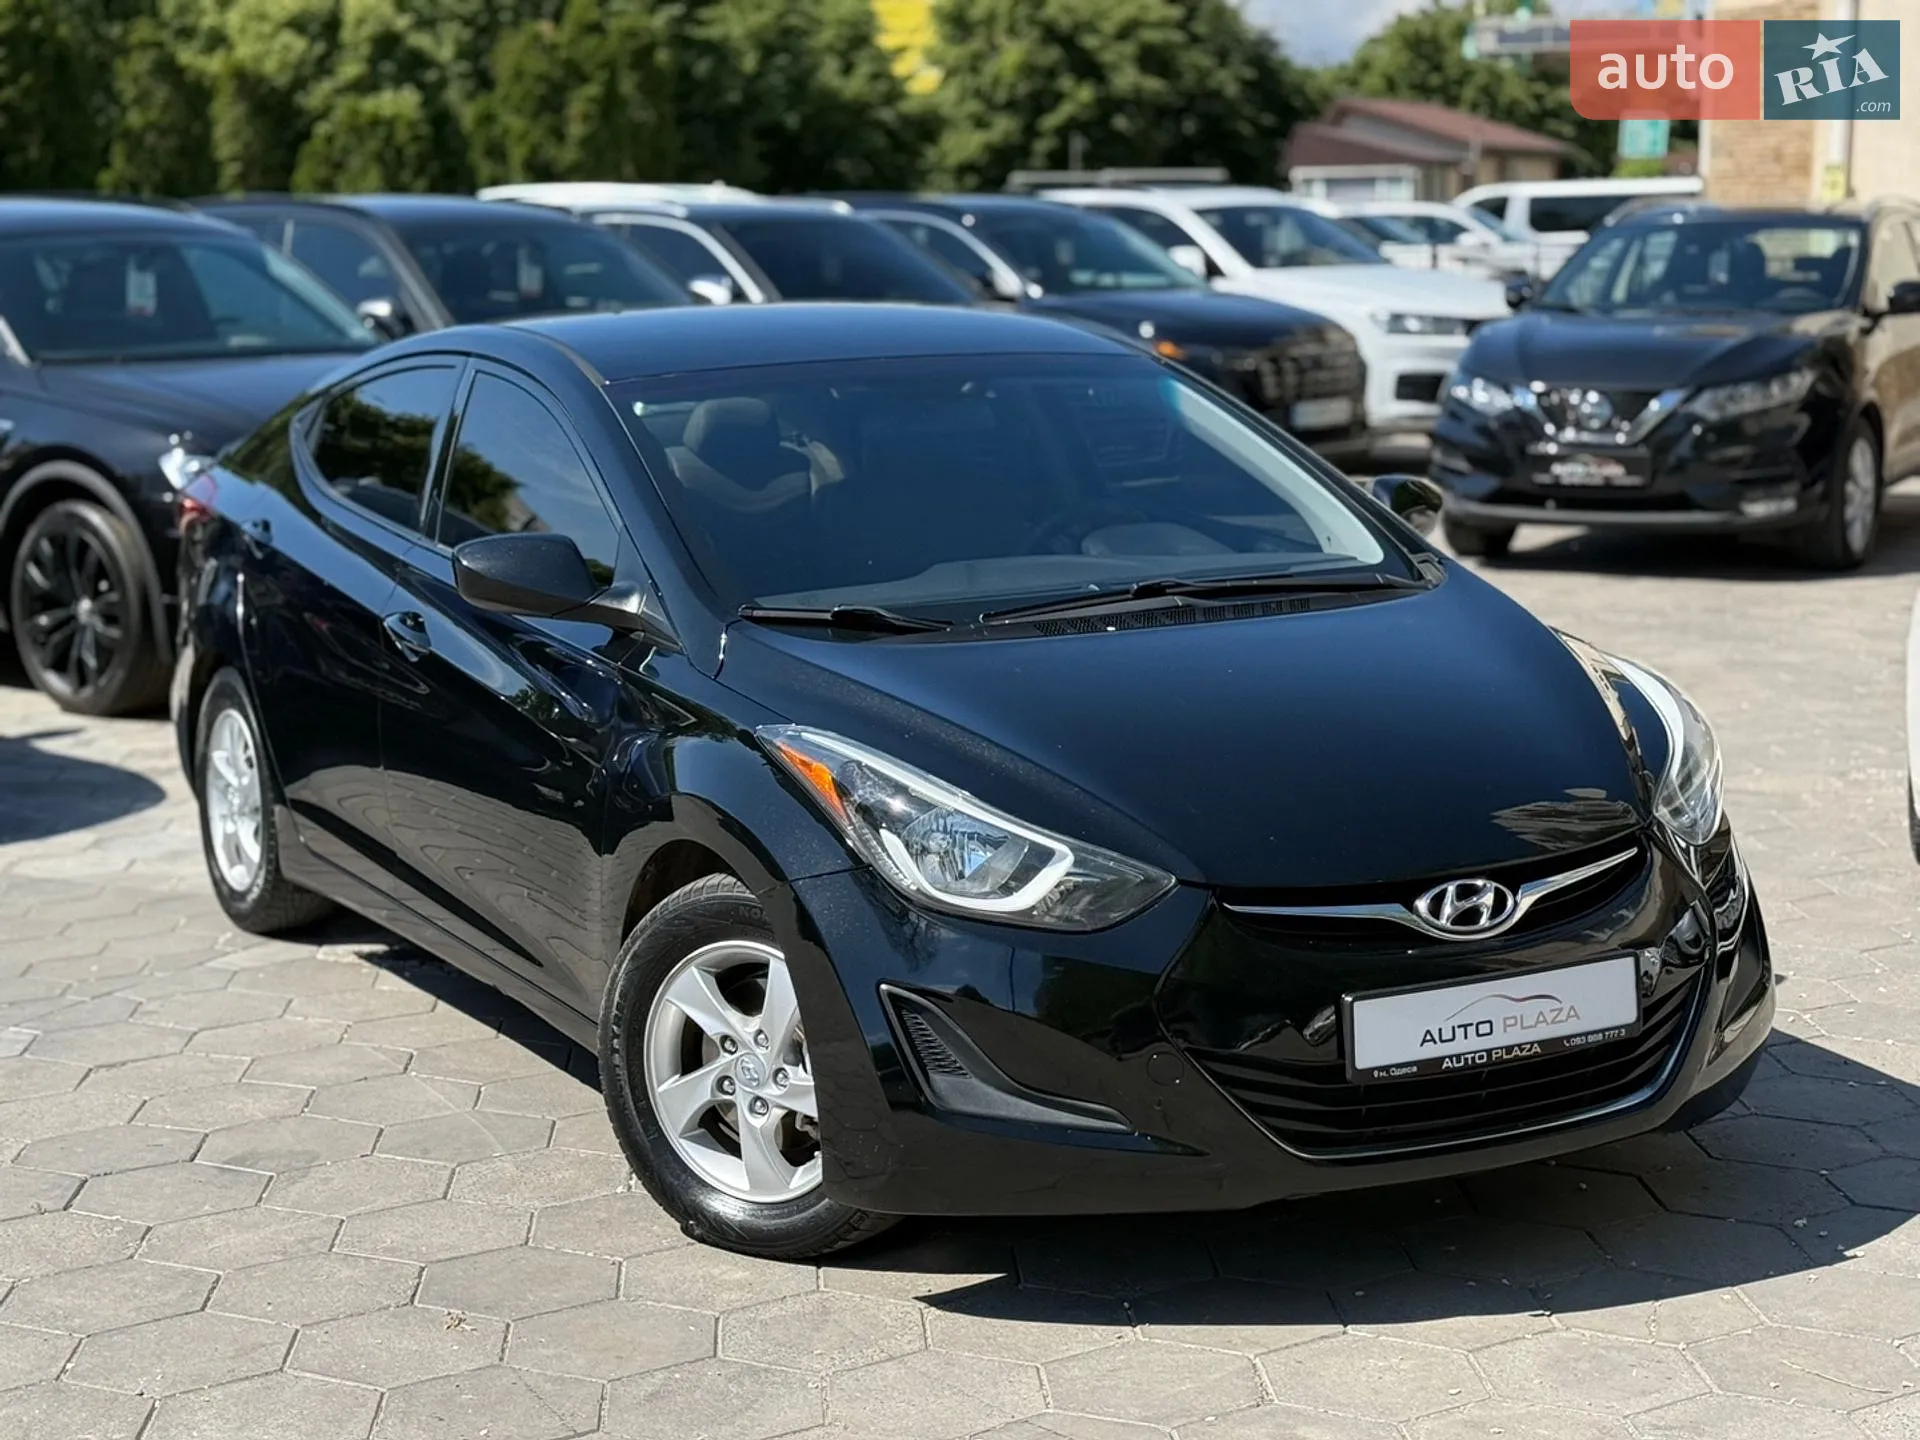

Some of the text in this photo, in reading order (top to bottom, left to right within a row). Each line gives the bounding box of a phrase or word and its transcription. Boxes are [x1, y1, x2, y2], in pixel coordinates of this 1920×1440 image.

[1419, 1004, 1581, 1048] AUTO PLAZA
[1441, 1043, 1542, 1070] AUTO PLAZA
